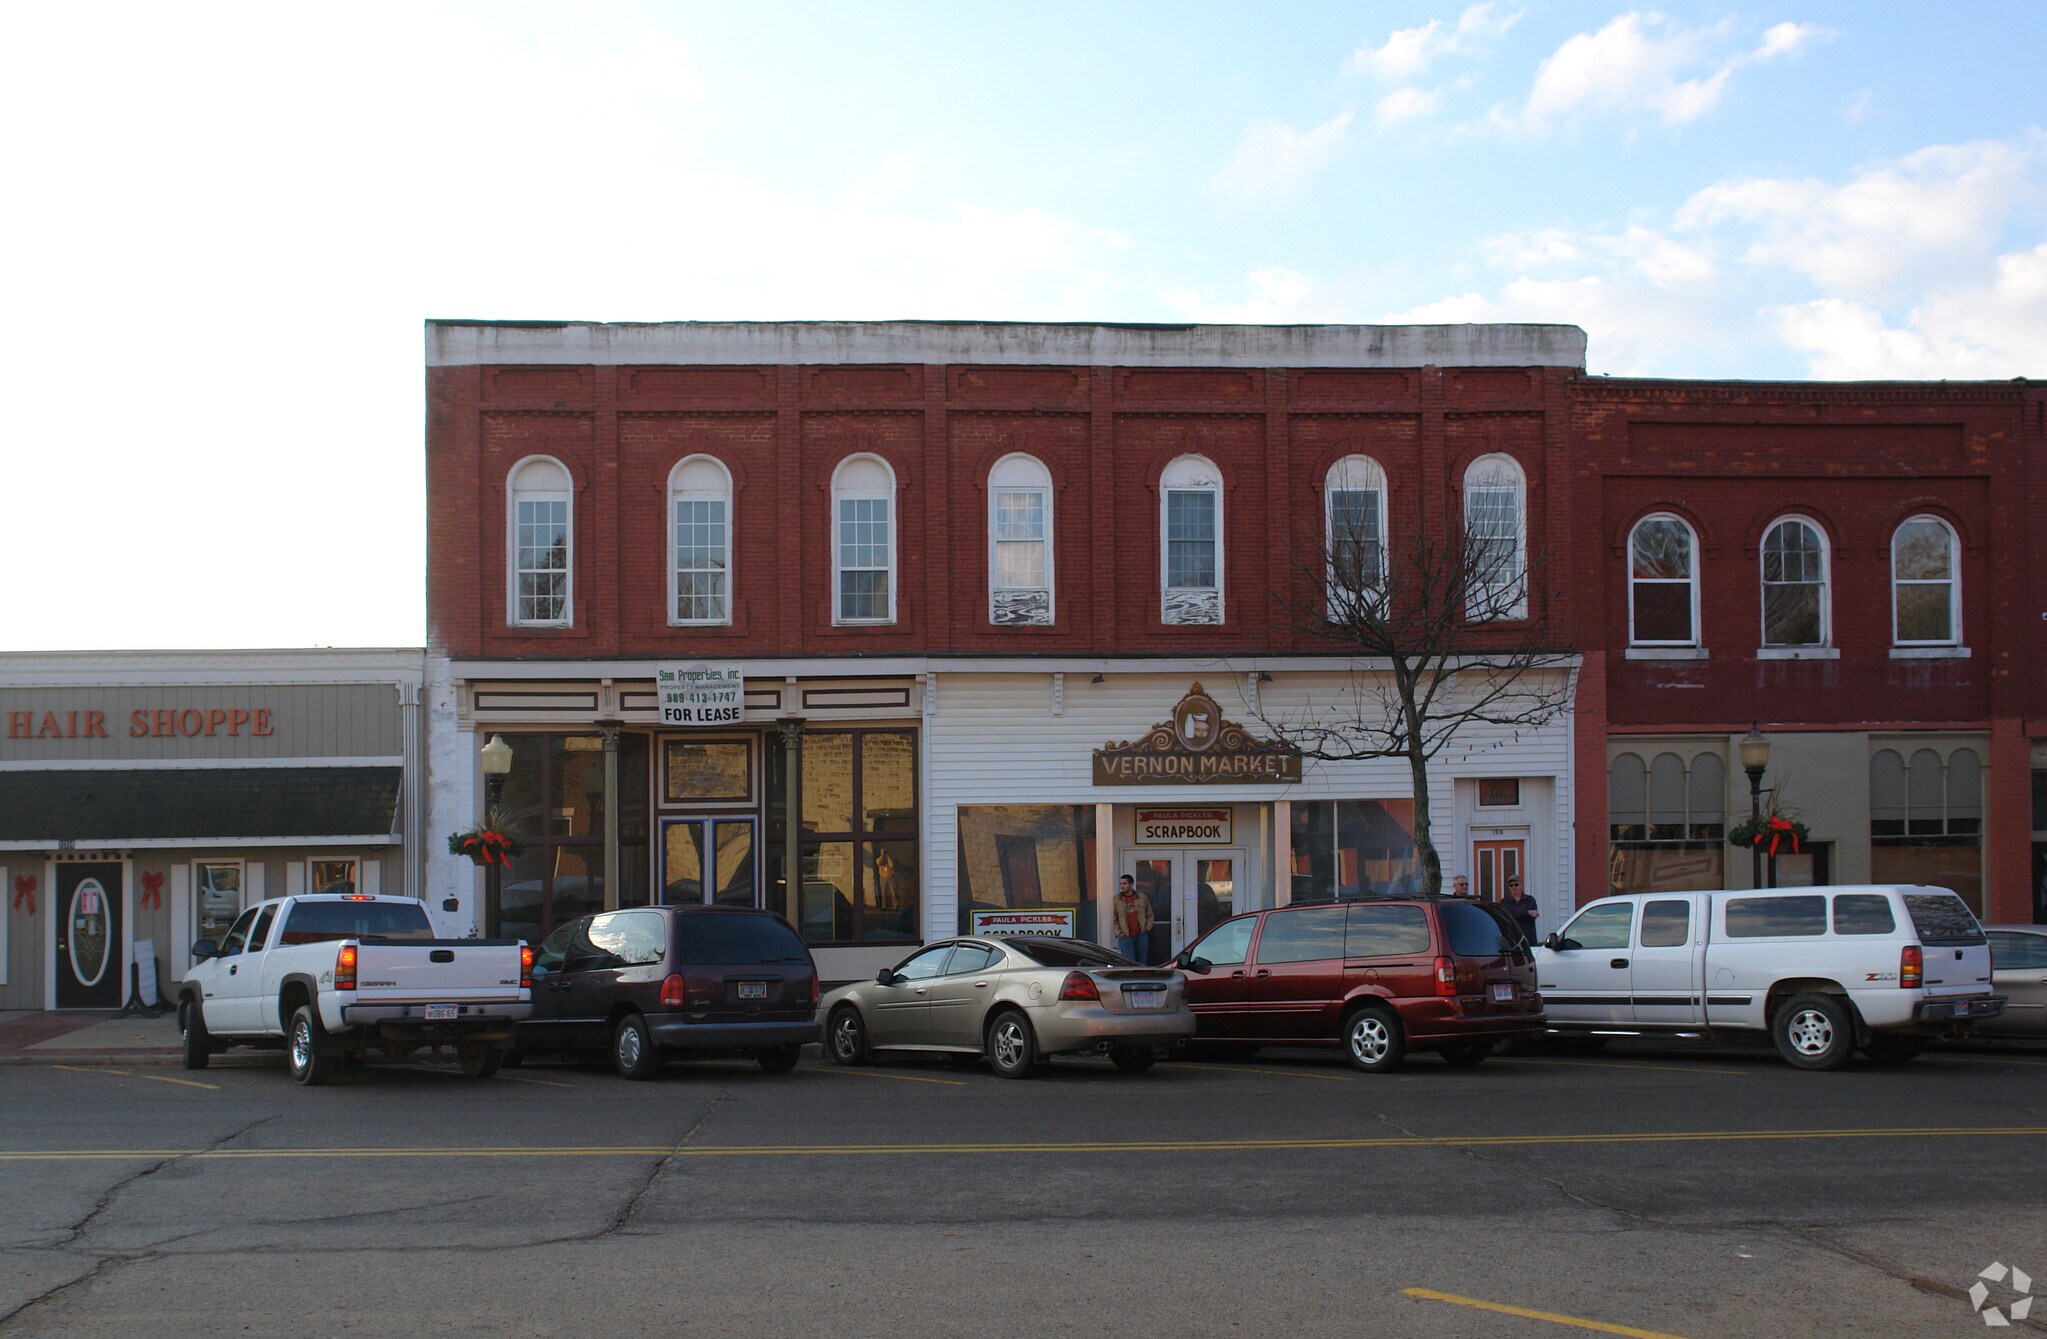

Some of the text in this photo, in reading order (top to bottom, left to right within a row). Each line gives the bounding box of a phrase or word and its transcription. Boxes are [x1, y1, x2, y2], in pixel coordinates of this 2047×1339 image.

[659, 669, 675, 681] Sam
[666, 692, 736, 703] 989-413-1747
[664, 707, 740, 721] FOR LEASE
[7, 708, 275, 738] HAIR SHOPPE
[1102, 754, 1291, 775] VERNON MARKET
[1146, 825, 1221, 838] SCRAPBOOK
